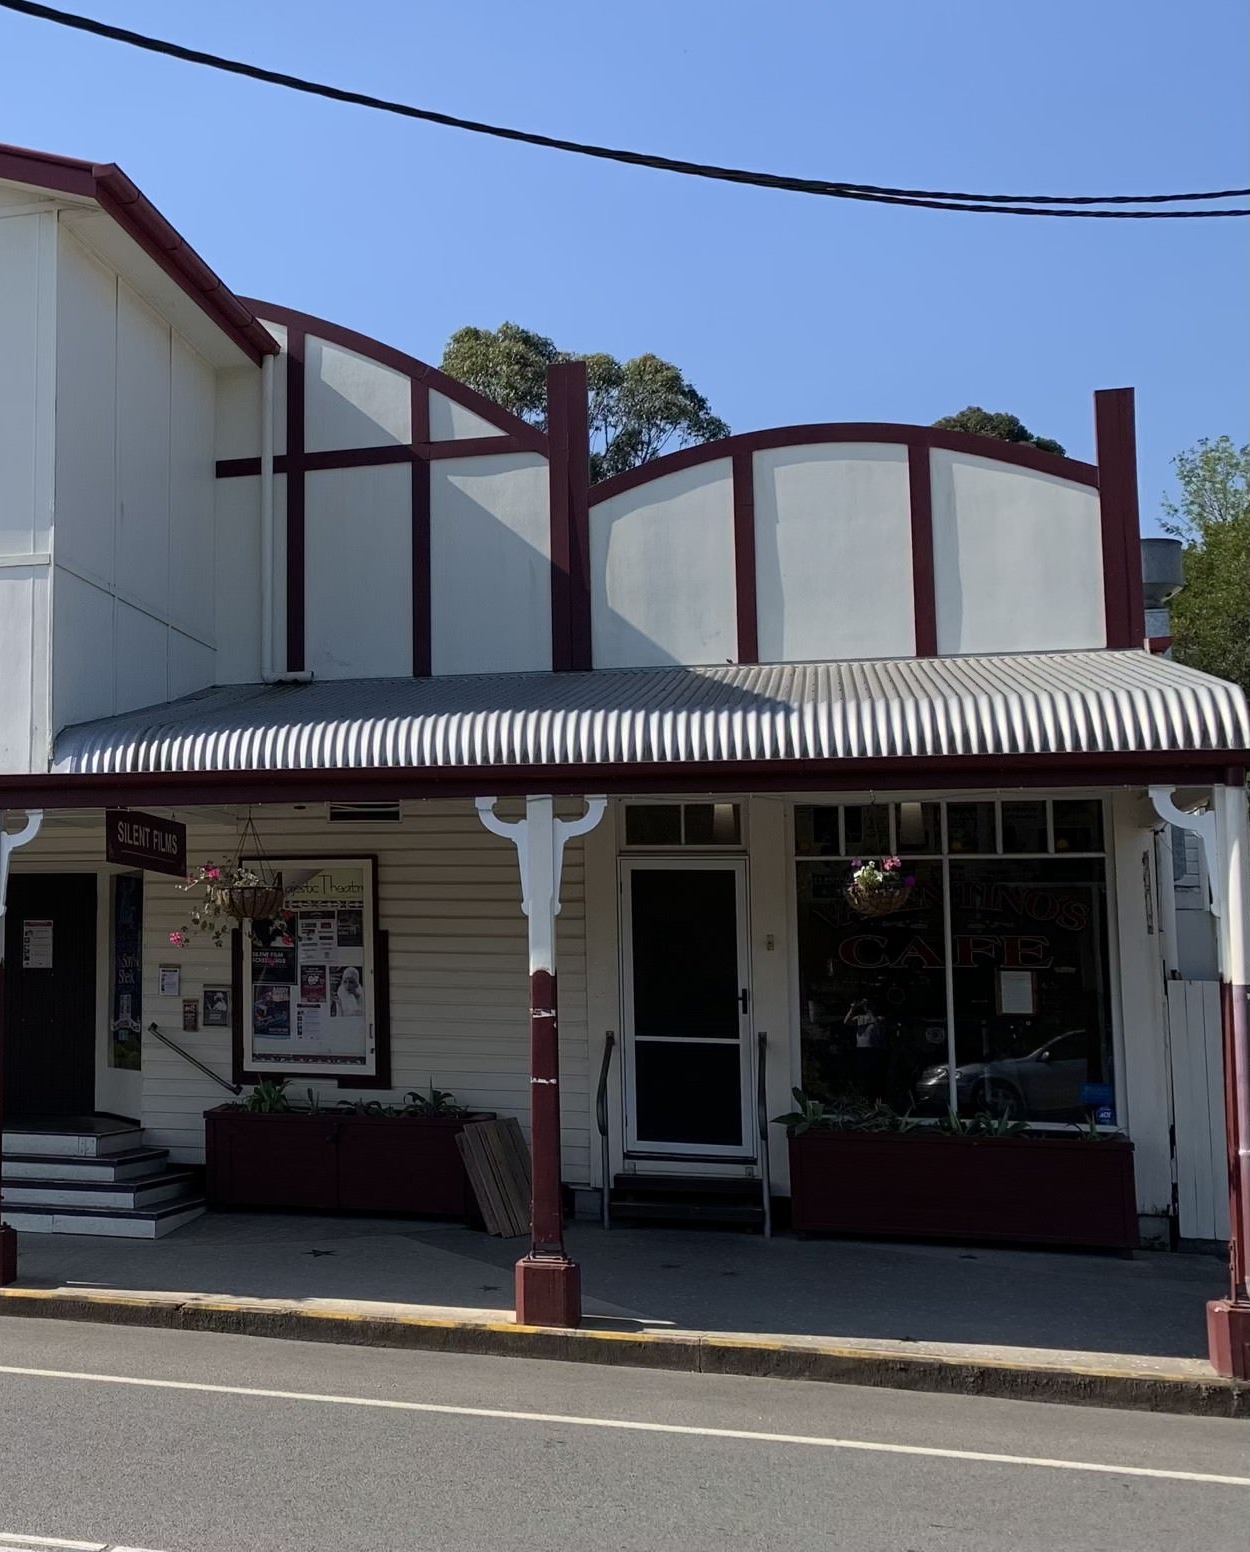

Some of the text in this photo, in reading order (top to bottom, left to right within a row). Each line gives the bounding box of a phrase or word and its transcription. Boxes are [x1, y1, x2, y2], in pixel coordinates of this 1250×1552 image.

[117, 821, 178, 855] SILENT FILMS
[838, 934, 1055, 969] CAFE
